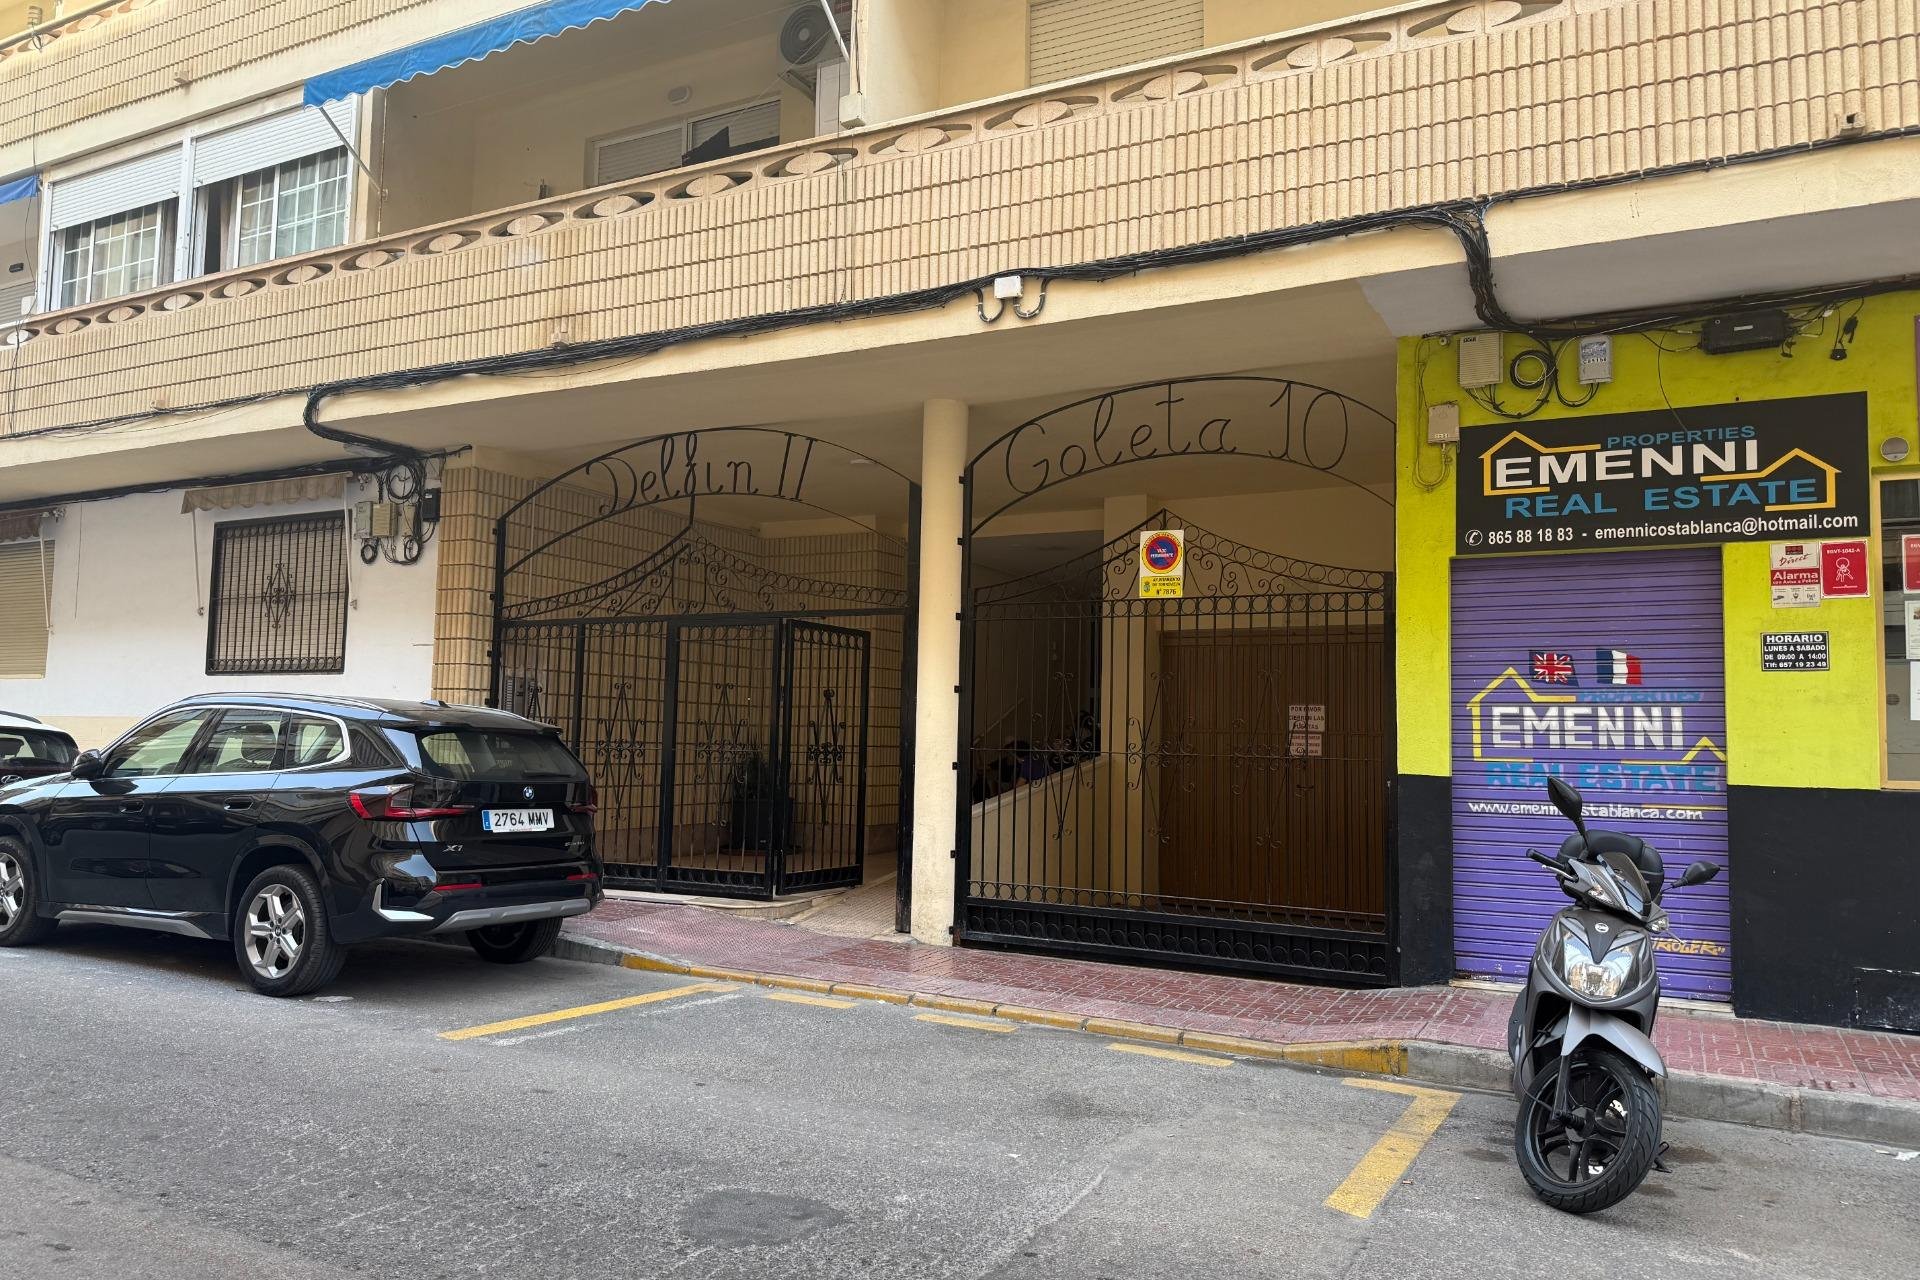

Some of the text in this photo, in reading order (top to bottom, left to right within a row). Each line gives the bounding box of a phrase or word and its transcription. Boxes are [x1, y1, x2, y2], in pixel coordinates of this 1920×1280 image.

[1269, 382, 1347, 471] 10
[1606, 425, 1757, 449] PROPERTIES
[1495, 439, 1759, 488] EMENNI
[1504, 478, 1818, 519] REAL ESTATE
[1488, 531, 1513, 545] 865
[1516, 529, 1533, 544] 88
[1537, 528, 1553, 542] 18
[1557, 527, 1574, 542] 83
[1595, 514, 1859, 540] emennicostablanca@hotmail.com
[1773, 571, 1819, 580] Alarma
[1766, 634, 1823, 643] HORARIO
[1491, 706, 1684, 750] EMENNI
[494, 812, 548, 827] 2764 MMV
